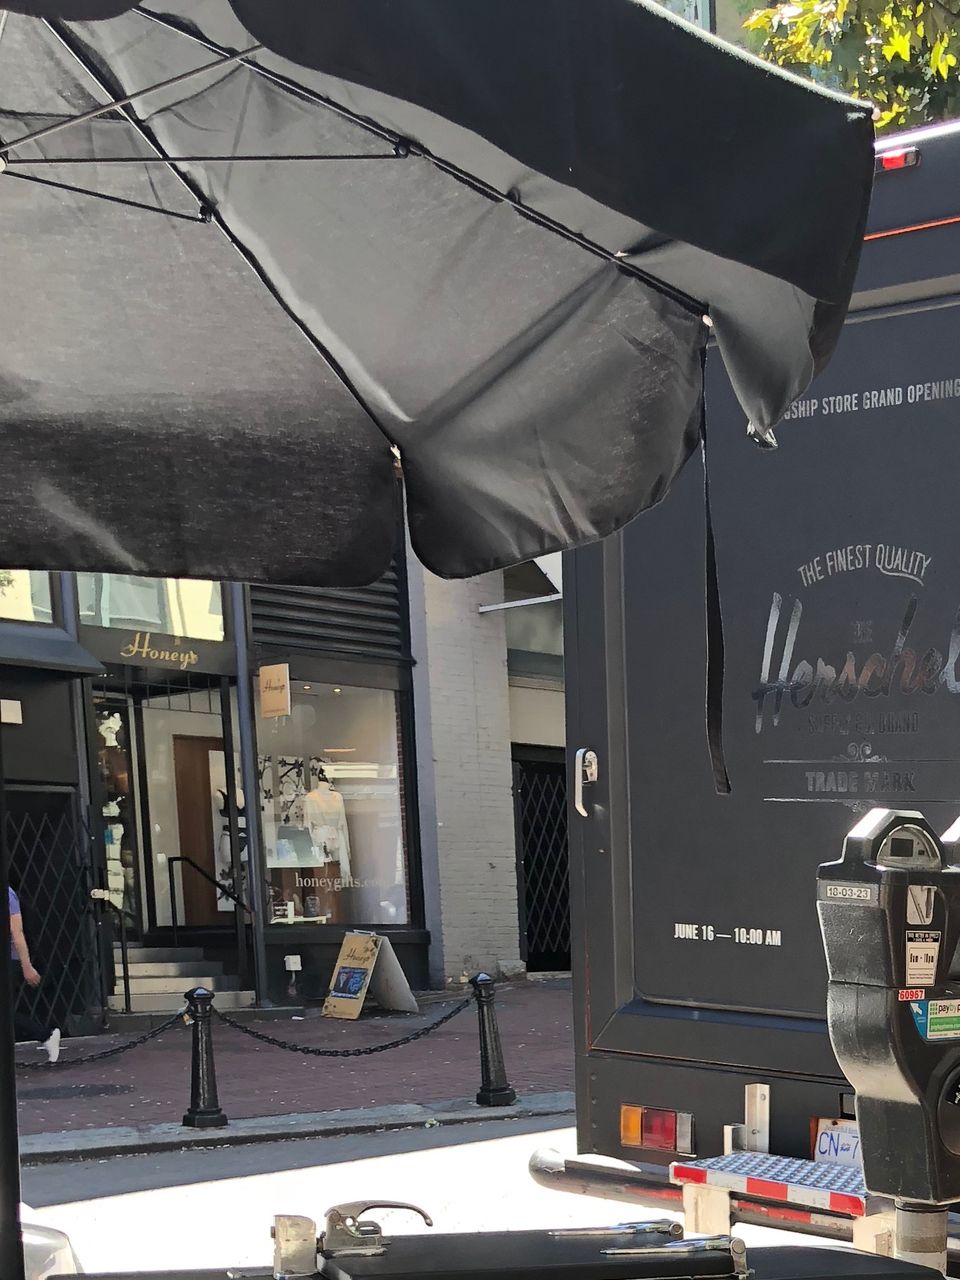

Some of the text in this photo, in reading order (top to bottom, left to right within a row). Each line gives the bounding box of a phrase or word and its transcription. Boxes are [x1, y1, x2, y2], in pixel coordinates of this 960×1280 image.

[822, 393, 859, 415] STORE
[863, 387, 903, 409] GRAND
[798, 544, 932, 587] THE FINEST QUALITY
[805, 771, 858, 793] TRADE
[828, 887, 870, 899] 18-03-23
[674, 923, 699, 940] JUNE
[702, 925, 714, 941] 16
[734, 927, 763, 945] 10:00
[765, 929, 782, 946] AM
